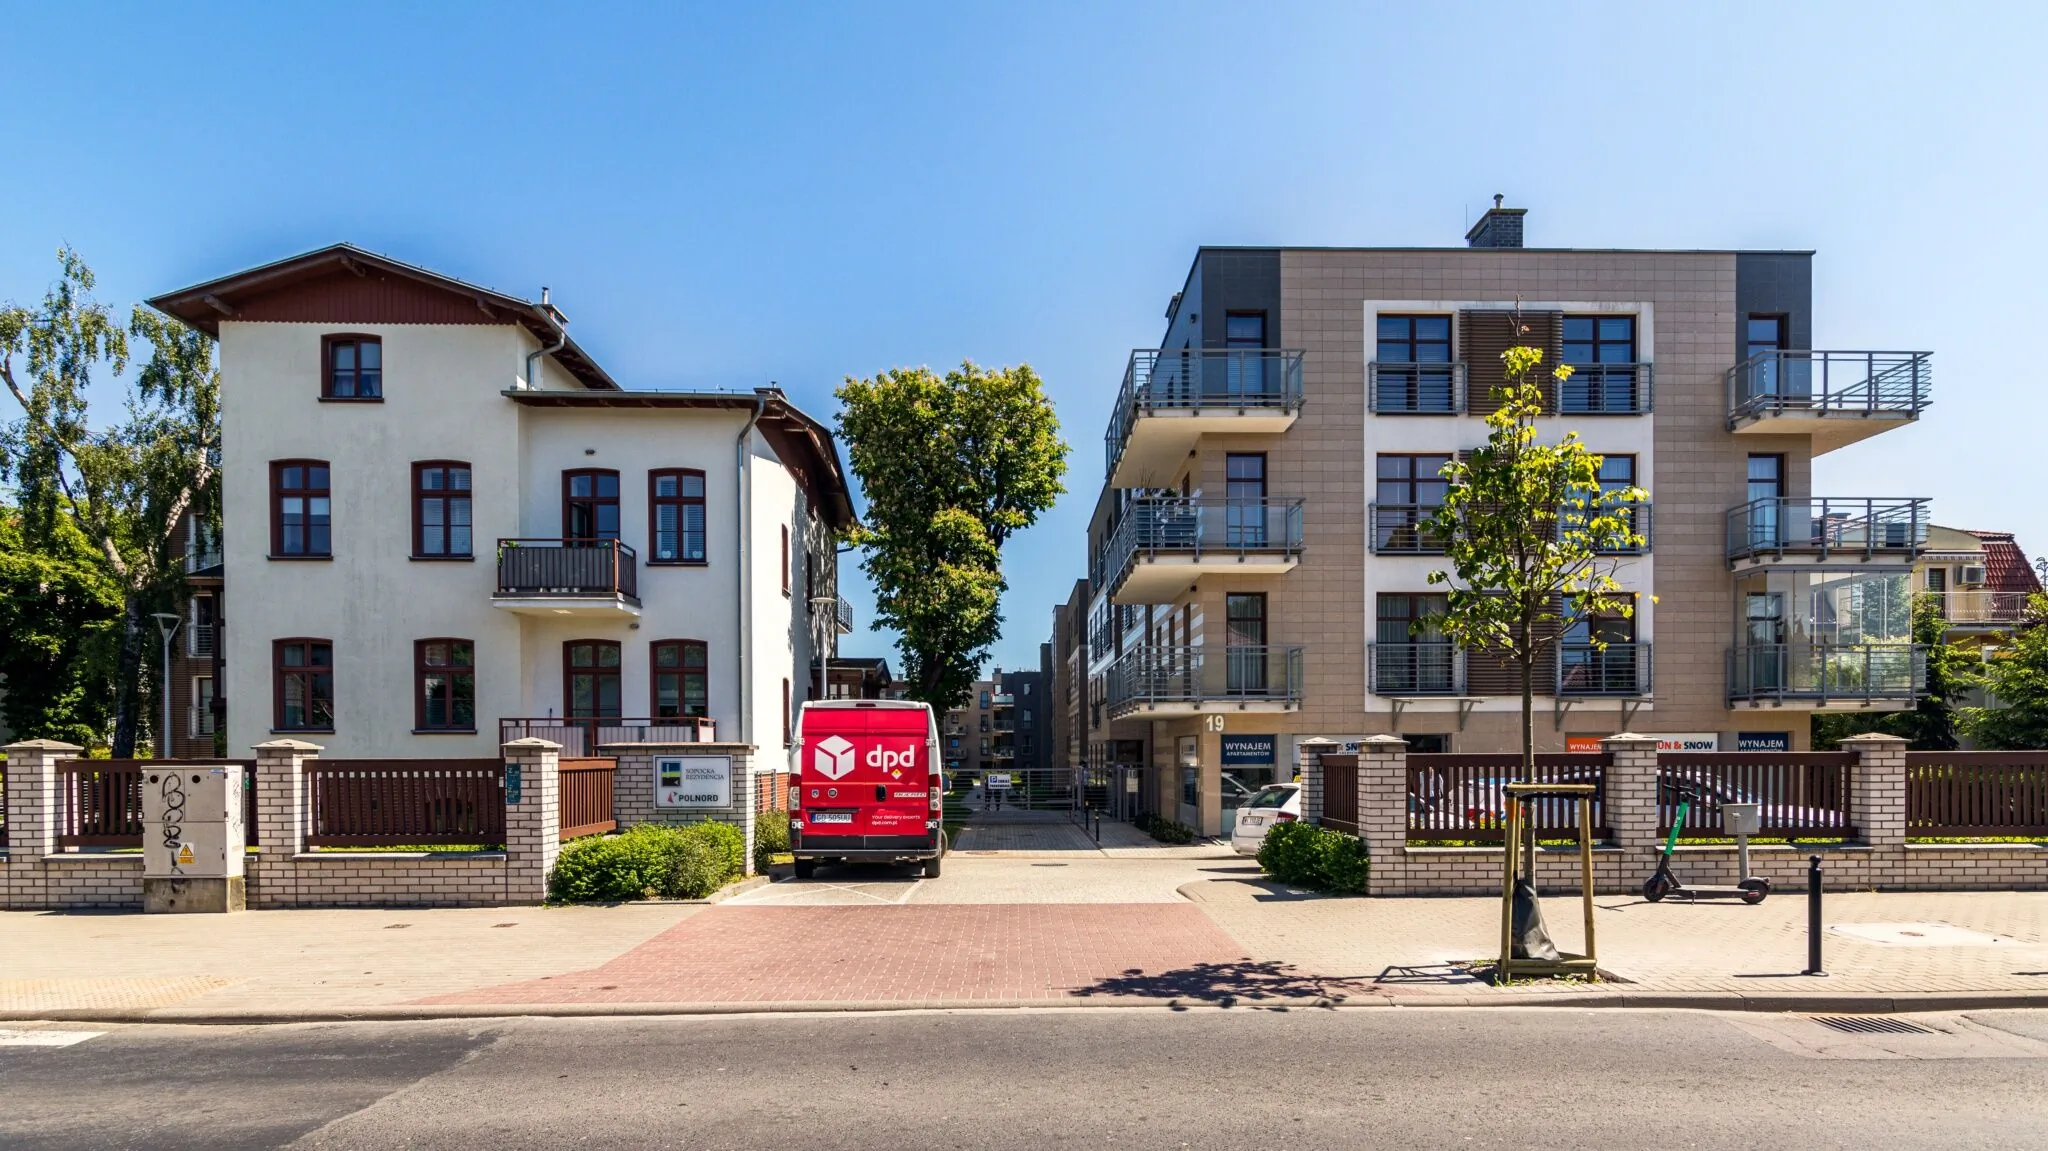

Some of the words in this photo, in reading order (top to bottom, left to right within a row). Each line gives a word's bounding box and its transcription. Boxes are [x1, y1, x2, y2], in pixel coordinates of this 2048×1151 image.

[1206, 715, 1225, 732] 19
[1225, 742, 1271, 751] WYNAJEM
[1656, 740, 1671, 750] UN
[1683, 741, 1713, 750] SNOW
[1739, 739, 1784, 748] WYNAJEM
[866, 744, 915, 773] dpd
[679, 794, 719, 802] POLNORD
